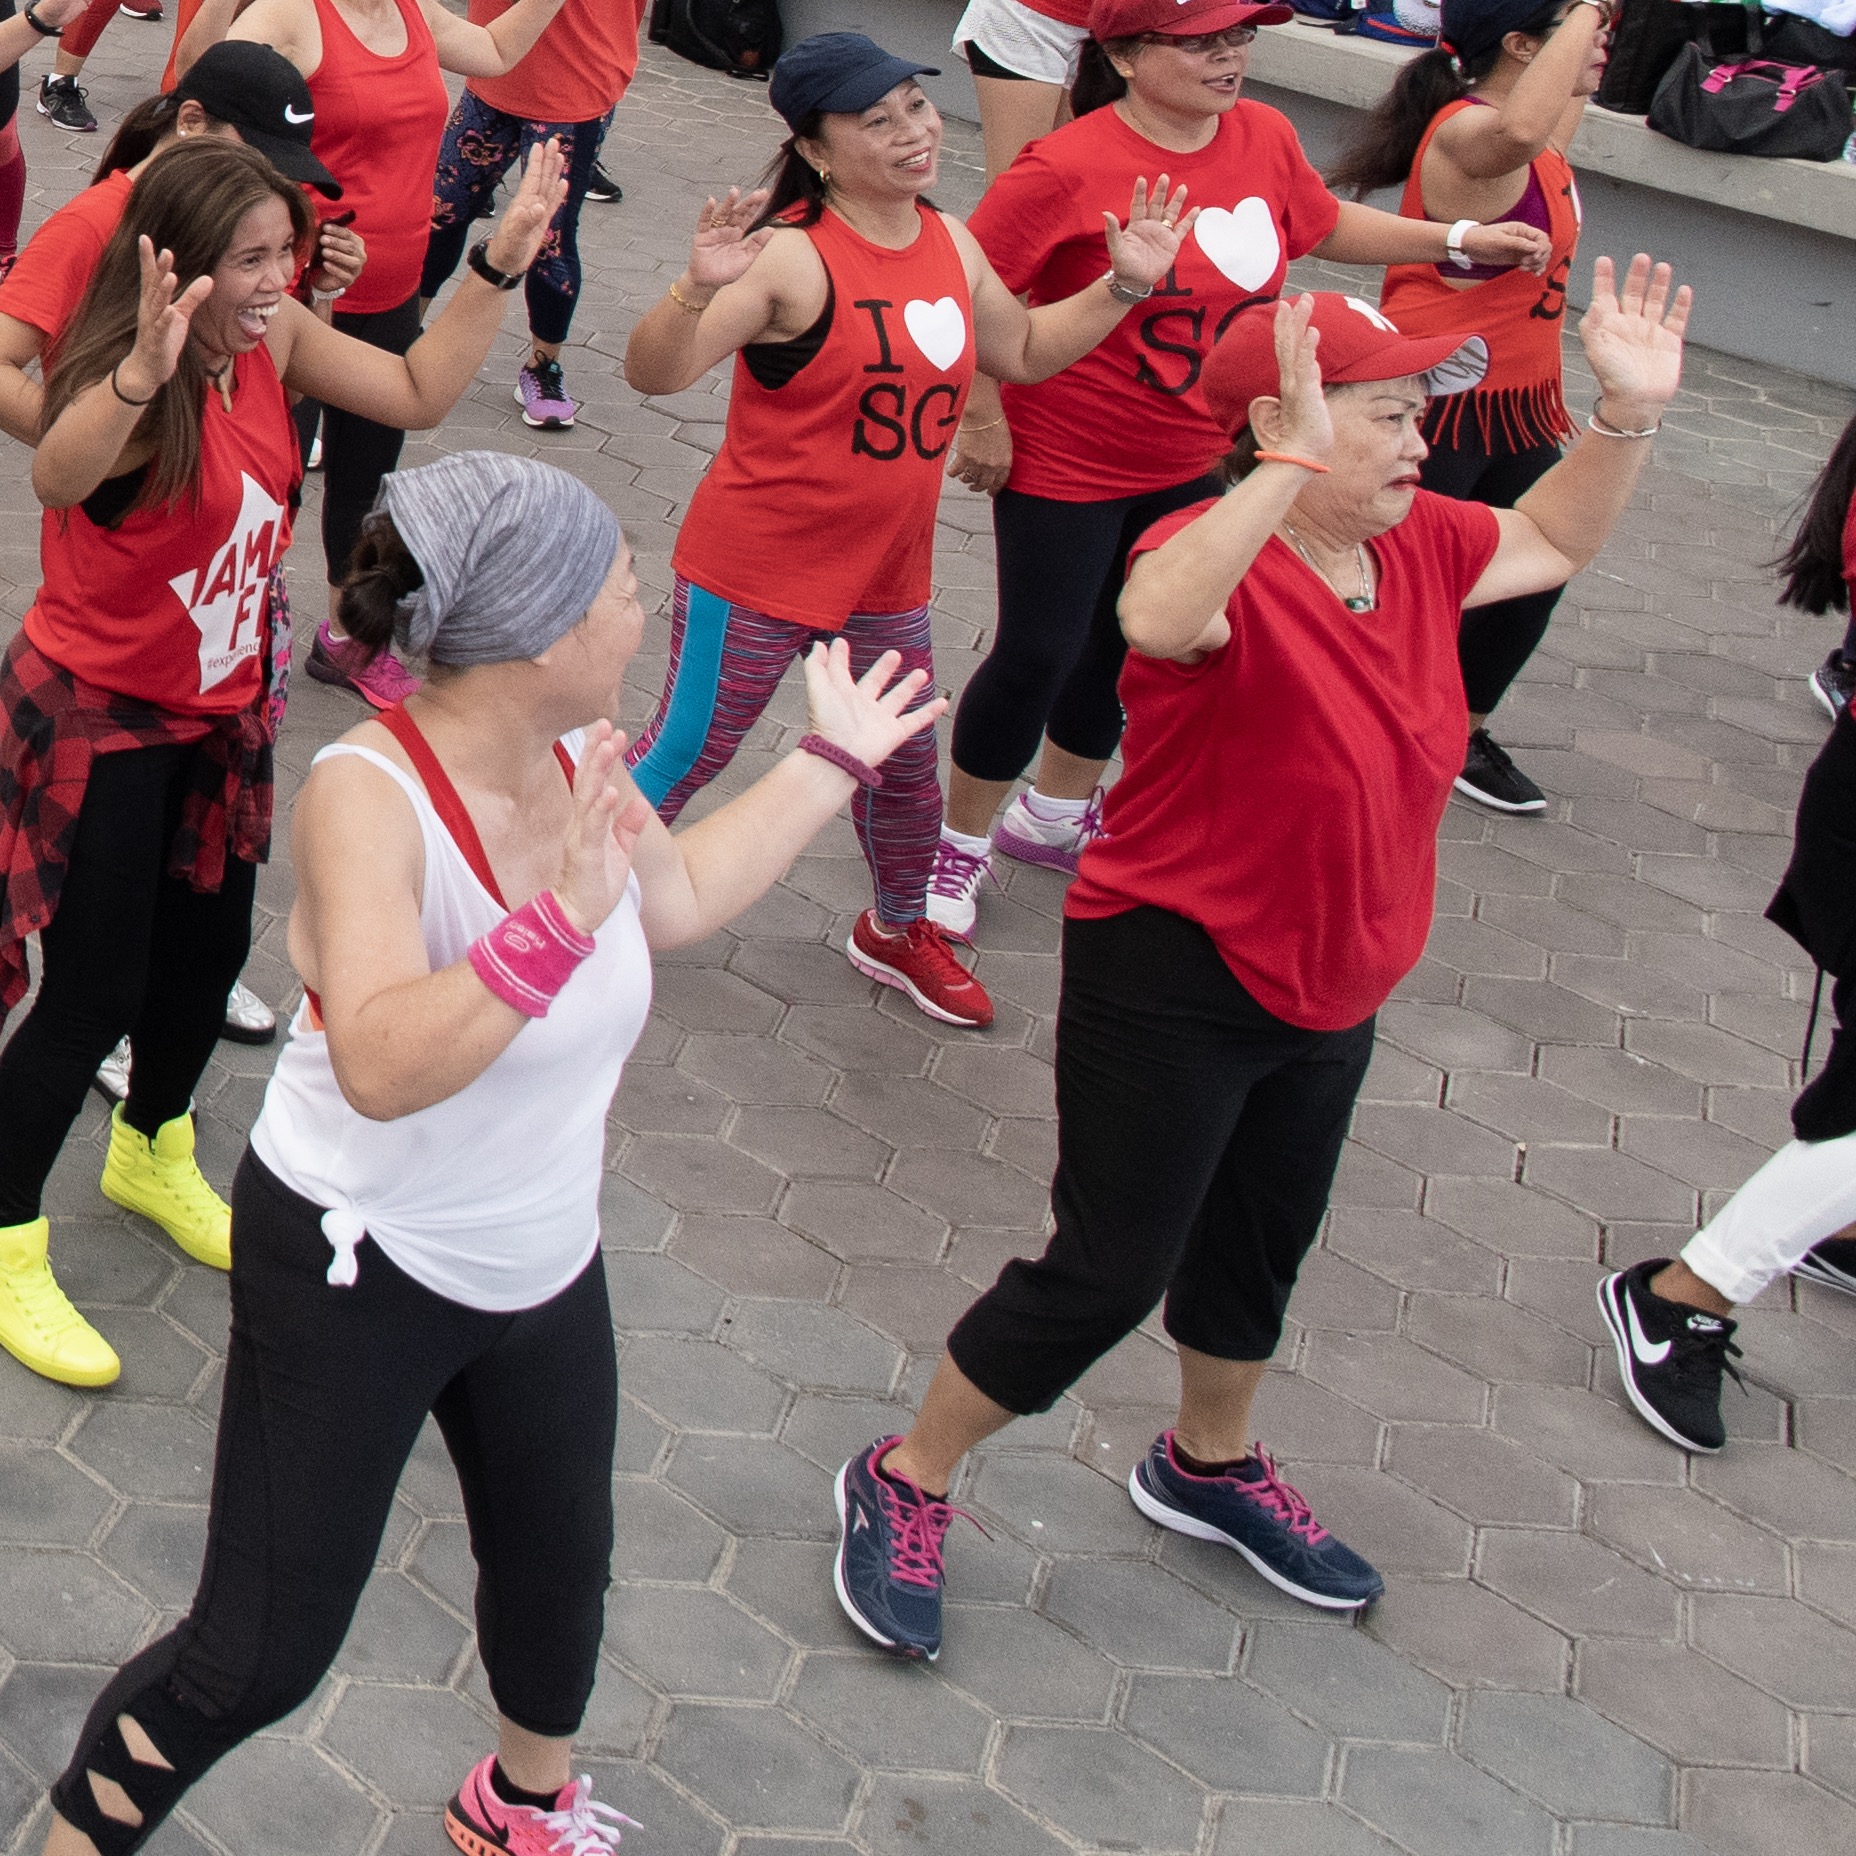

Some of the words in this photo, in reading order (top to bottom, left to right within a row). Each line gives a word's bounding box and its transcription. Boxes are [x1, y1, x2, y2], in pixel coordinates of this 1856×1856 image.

[853, 299, 904, 374] I
[851, 384, 962, 462] SG
[207, 532, 268, 606] AM
[229, 577, 268, 650] FI
